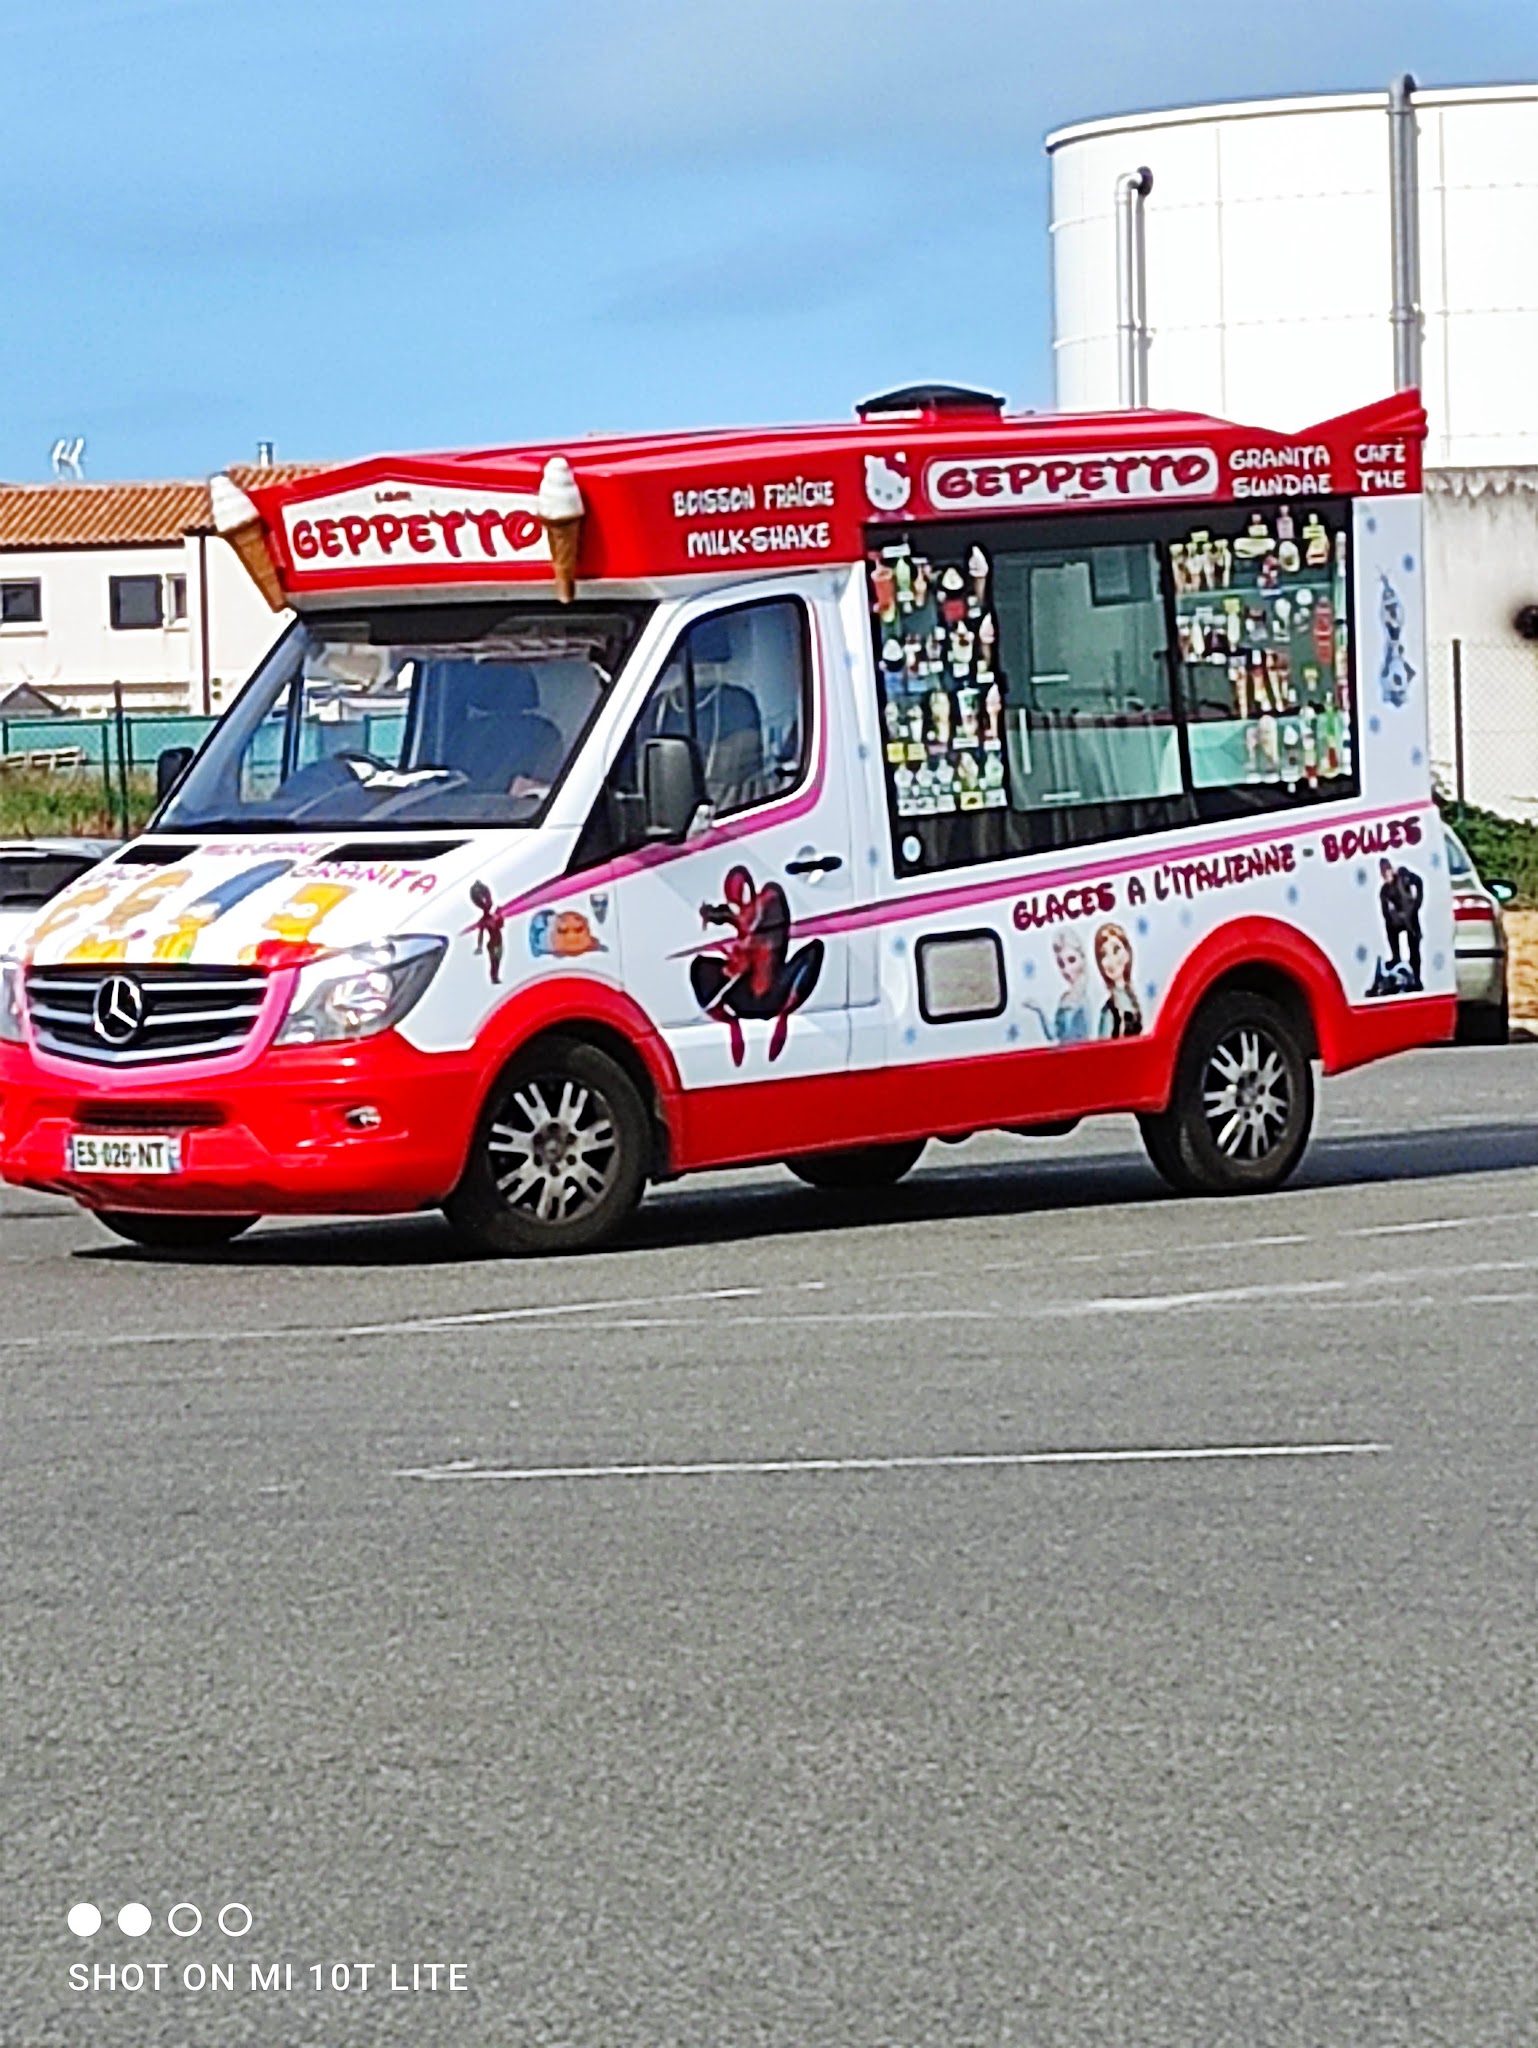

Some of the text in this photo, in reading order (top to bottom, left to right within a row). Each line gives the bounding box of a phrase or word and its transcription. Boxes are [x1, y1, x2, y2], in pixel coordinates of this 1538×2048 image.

[1229, 445, 1330, 471] GRANITA
[936, 455, 1210, 498] GEPPETTO
[1232, 473, 1332, 499] SUNDAE
[1356, 469, 1406, 492] THE
[673, 484, 754, 517] BOISSON
[292, 508, 543, 559] GEPPETTO
[687, 522, 831, 558] MILK-SHAKE
[1013, 888, 1116, 931] GLACES
[1127, 877, 1146, 906] A
[1155, 844, 1294, 900] L'ITALIENNE
[1322, 815, 1422, 862] BOULES
